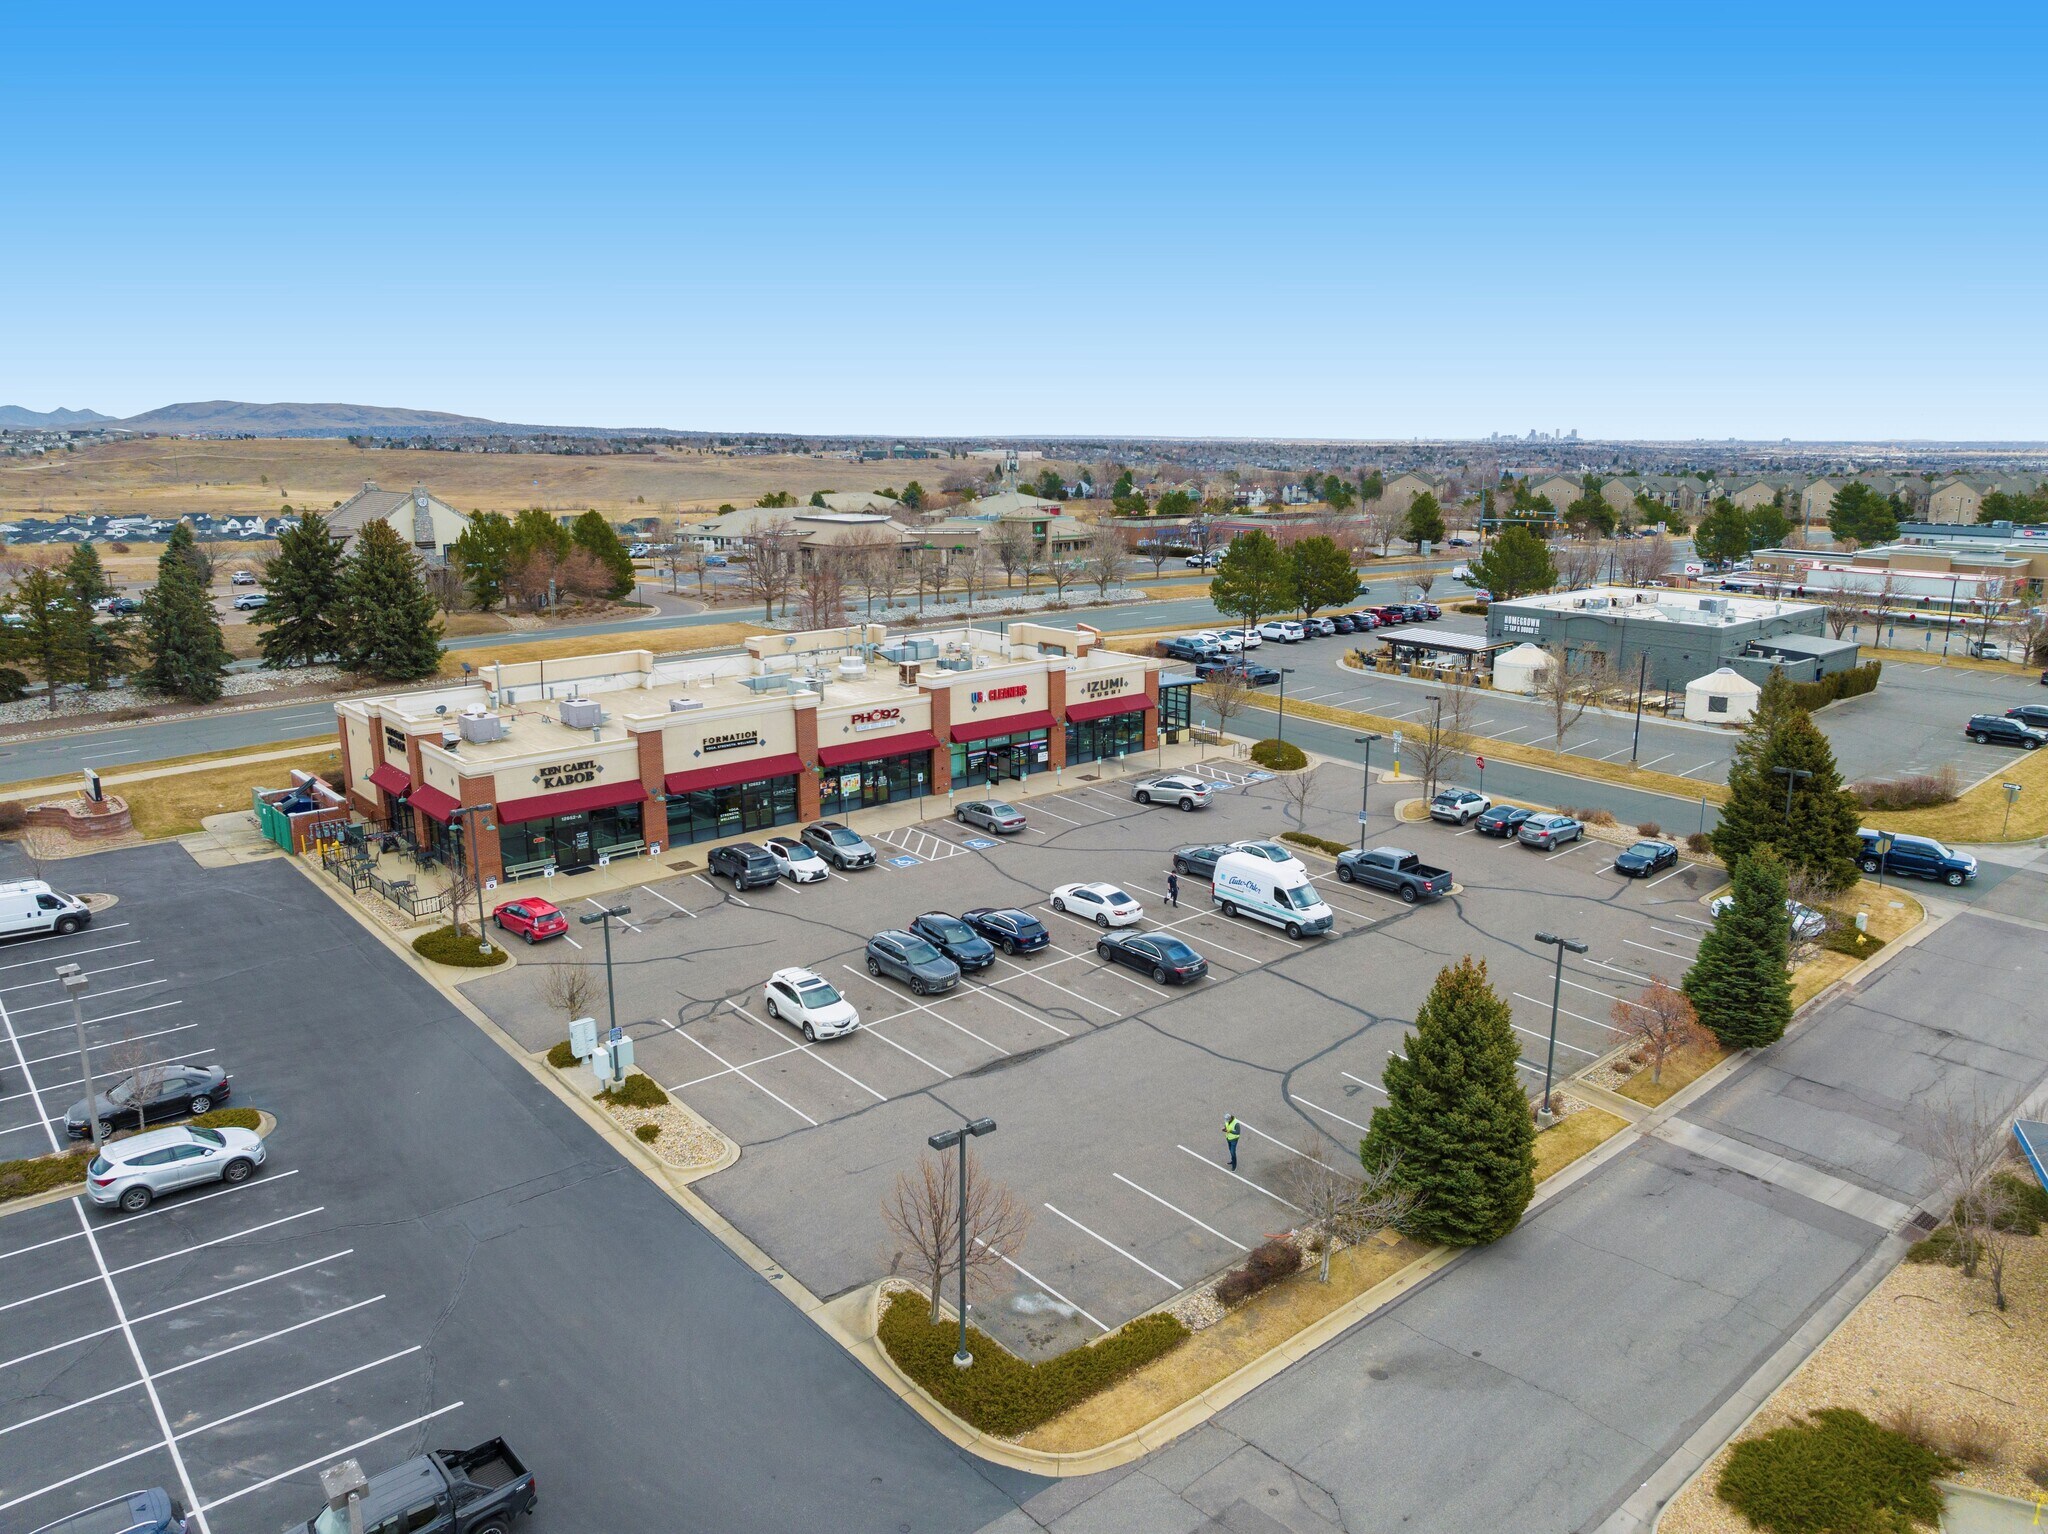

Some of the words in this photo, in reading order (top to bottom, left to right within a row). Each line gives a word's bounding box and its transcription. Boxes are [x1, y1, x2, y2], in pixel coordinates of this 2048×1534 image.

[1504, 616, 1540, 628] HOMEGROWN
[1087, 677, 1124, 692] IZUMI
[988, 685, 1027, 701] CLEANERS
[1090, 689, 1121, 698] SUSHI
[702, 730, 758, 745] FORMATION
[539, 765, 562, 777] KEN
[562, 760, 597, 773] CARYL
[543, 771, 595, 789] KABOB
